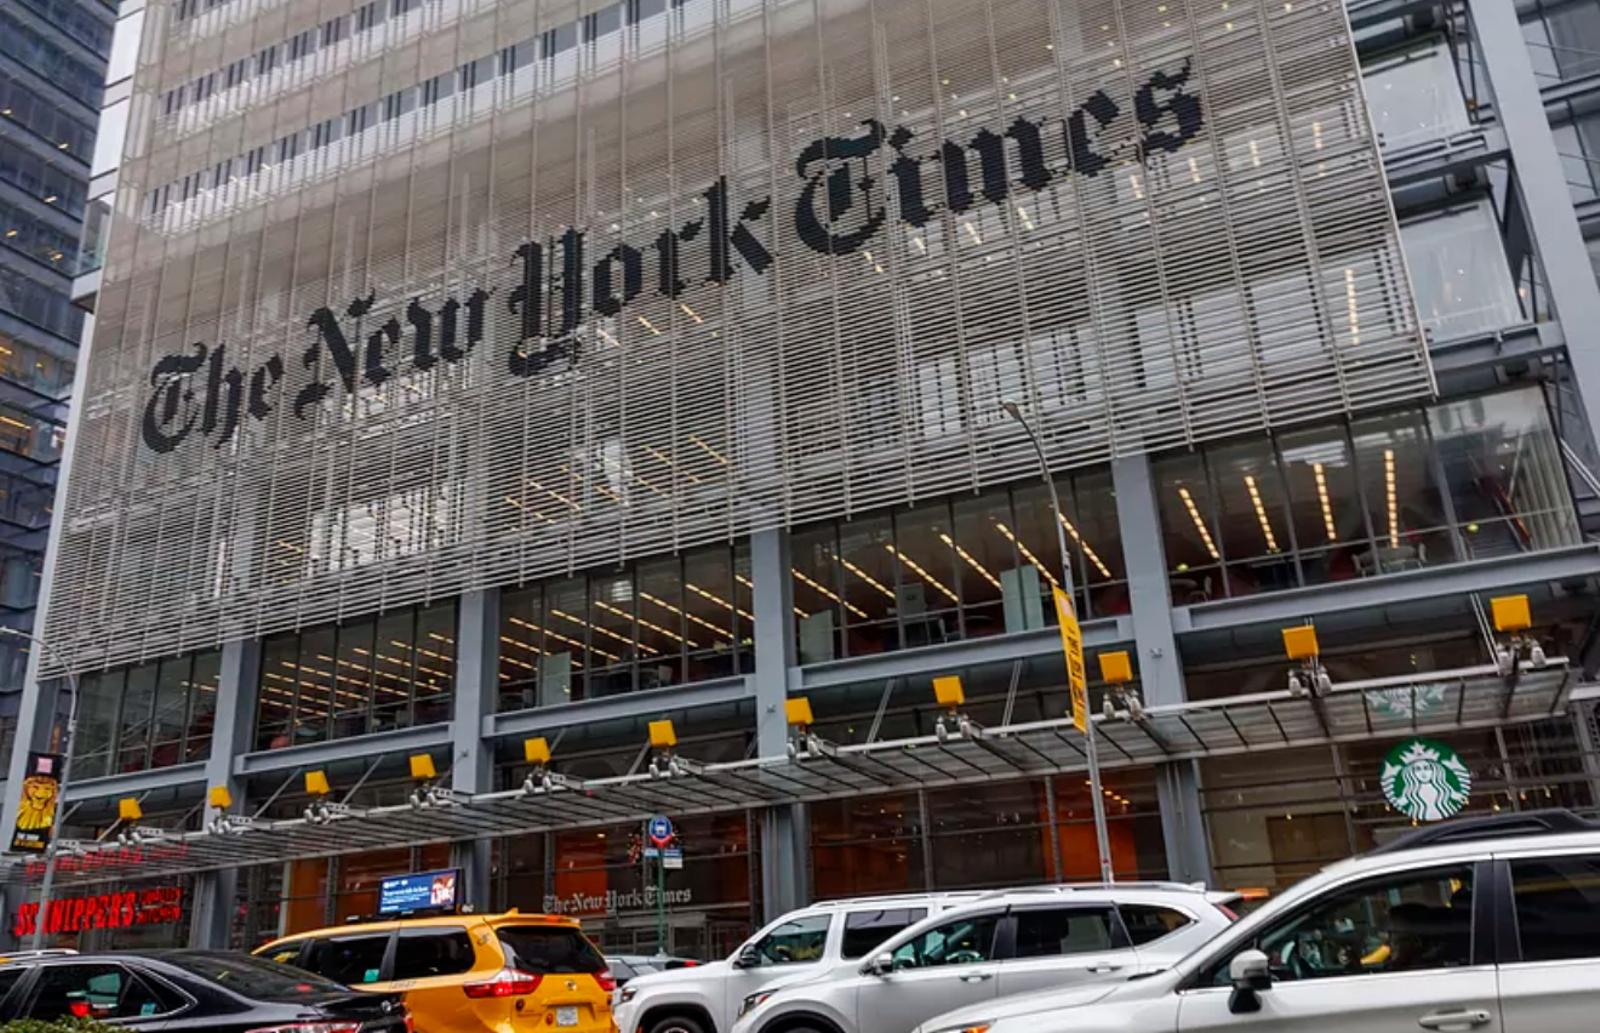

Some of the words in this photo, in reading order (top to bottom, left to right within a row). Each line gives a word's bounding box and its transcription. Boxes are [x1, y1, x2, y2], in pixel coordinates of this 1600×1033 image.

[143, 342, 284, 454] The
[294, 287, 496, 421] New
[507, 174, 777, 378] York
[795, 55, 1204, 255] Times
[542, 895, 571, 914] The
[569, 891, 604, 913] New
[605, 888, 643, 914] York
[644, 884, 692, 906] Tmes
